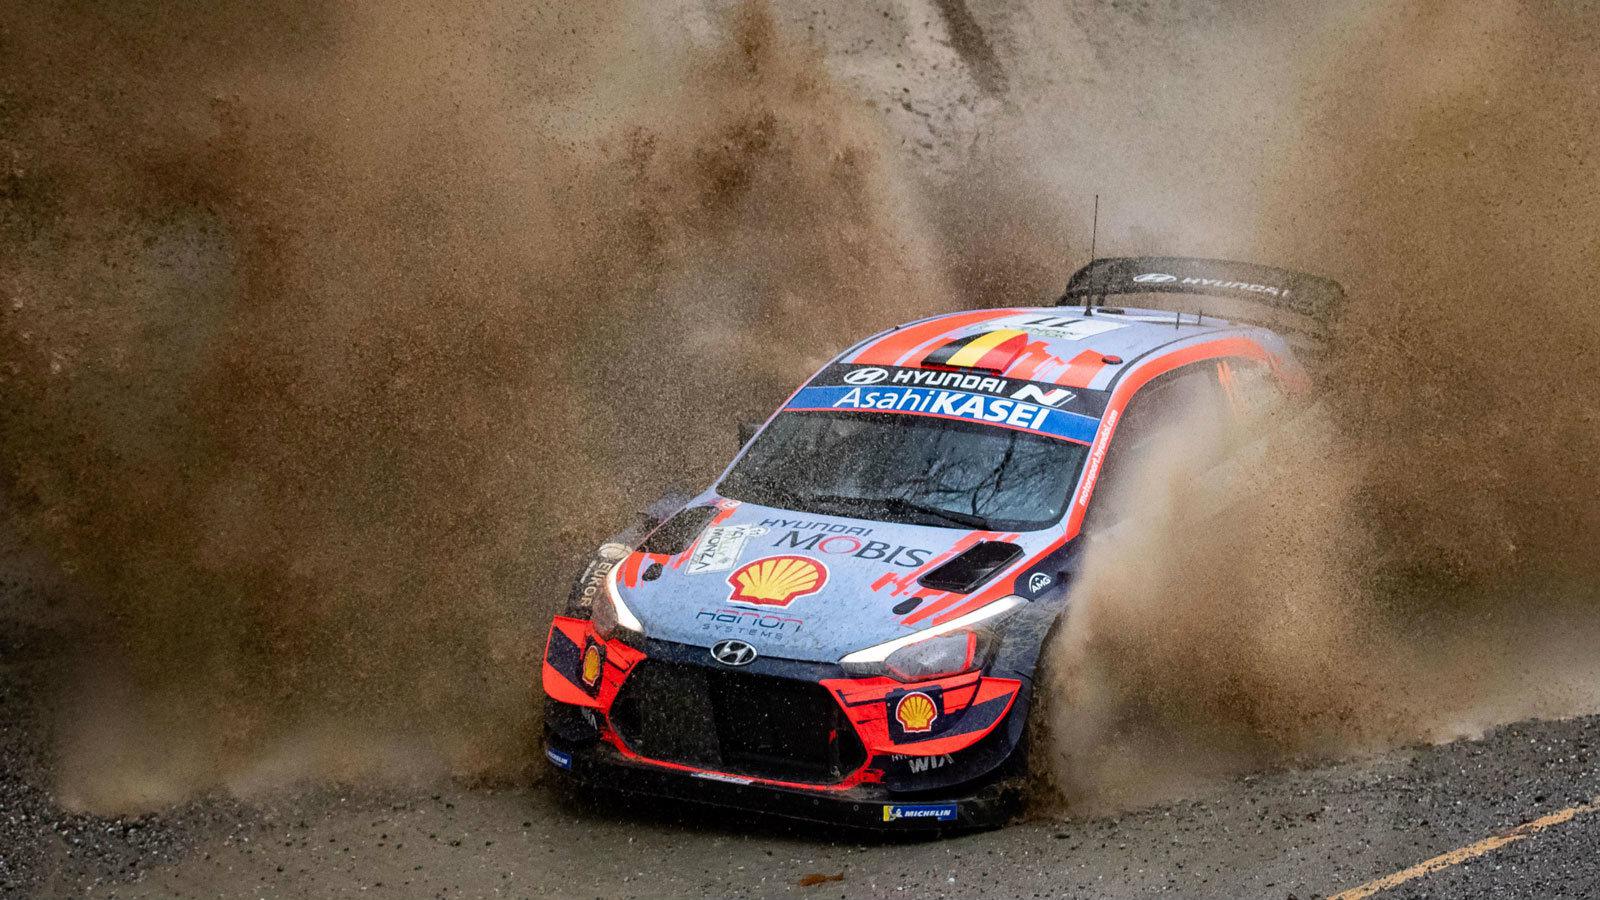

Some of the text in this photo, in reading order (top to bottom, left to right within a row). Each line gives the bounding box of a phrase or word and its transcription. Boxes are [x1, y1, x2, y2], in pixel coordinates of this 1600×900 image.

[892, 370, 1076, 407] HYUNDAI N
[832, 388, 1050, 430] AsahiKASEI
[1079, 409, 1119, 506] motorsport.hyundai.com
[760, 518, 874, 537] HYUNDAI
[695, 528, 724, 571] MONZA
[772, 530, 933, 568] MOBIS
[1032, 575, 1052, 594] AMG
[702, 623, 784, 640] SYSTEMS
[904, 809, 952, 818] MICHELIN
